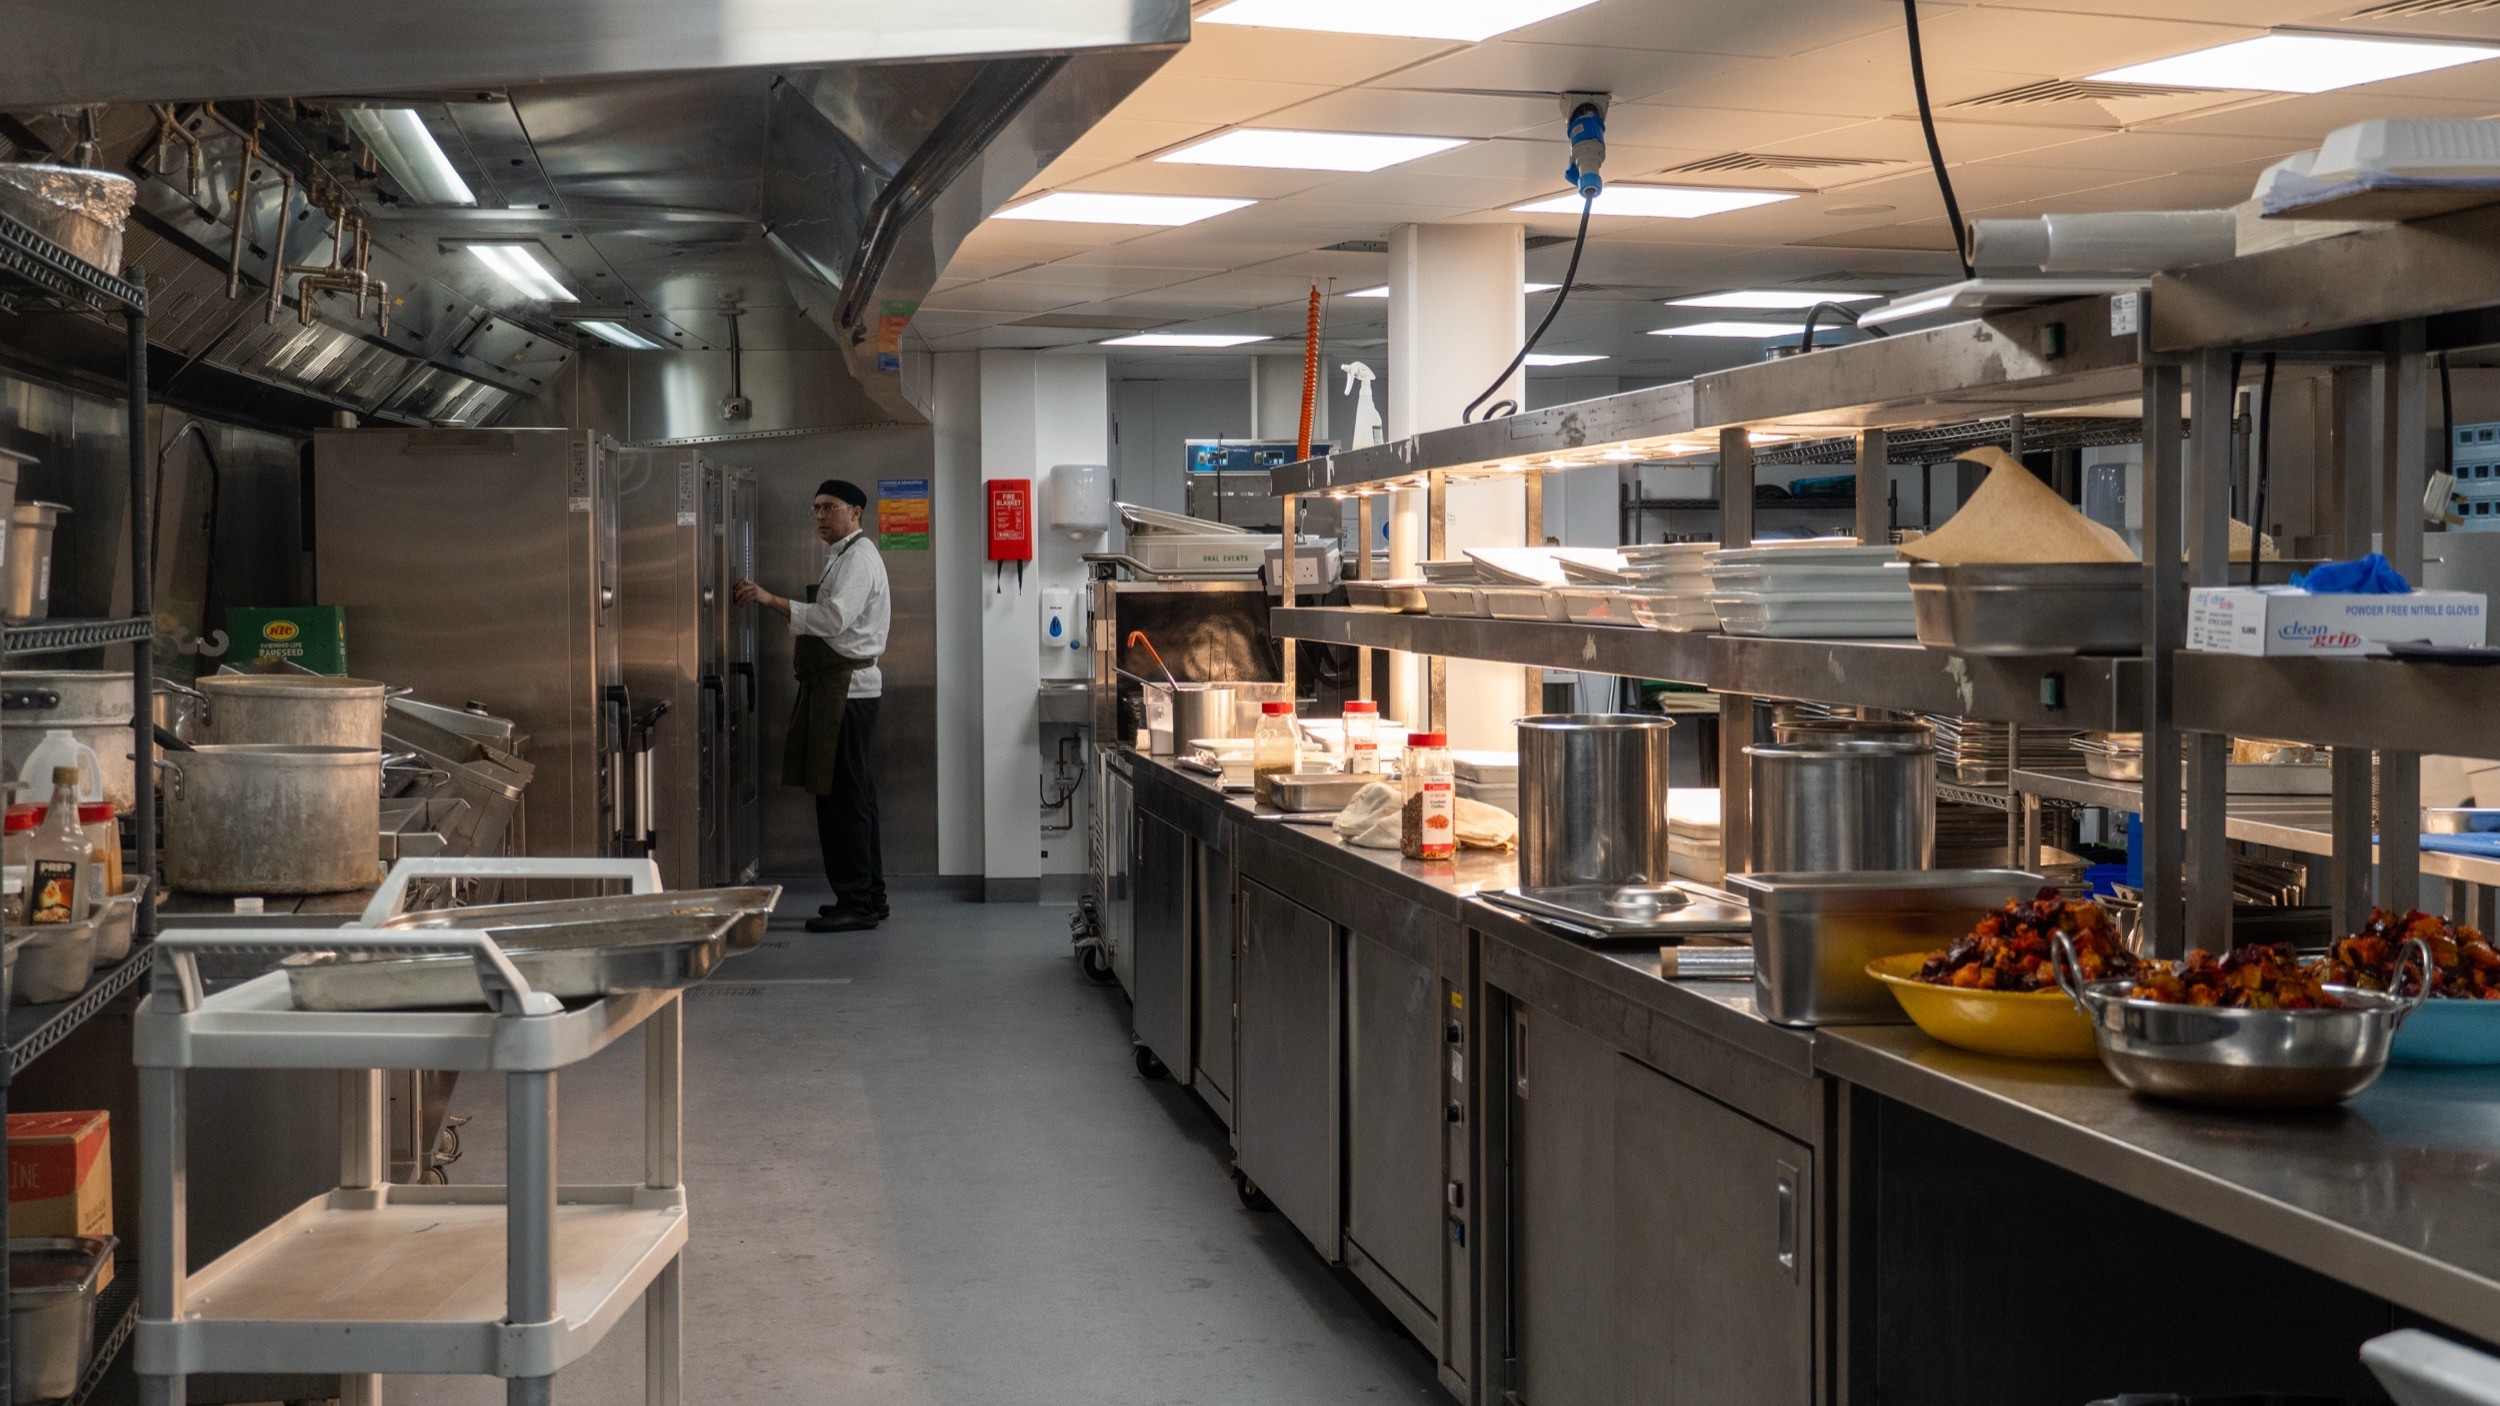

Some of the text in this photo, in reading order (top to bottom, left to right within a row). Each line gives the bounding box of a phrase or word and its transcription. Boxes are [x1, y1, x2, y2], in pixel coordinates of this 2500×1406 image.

[2345, 604, 2480, 616] POWDER FREE NITRILE GLOVES
[2282, 621, 2328, 635] clean
[2313, 632, 2358, 648] grip
[40, 862, 72, 872] PREP
